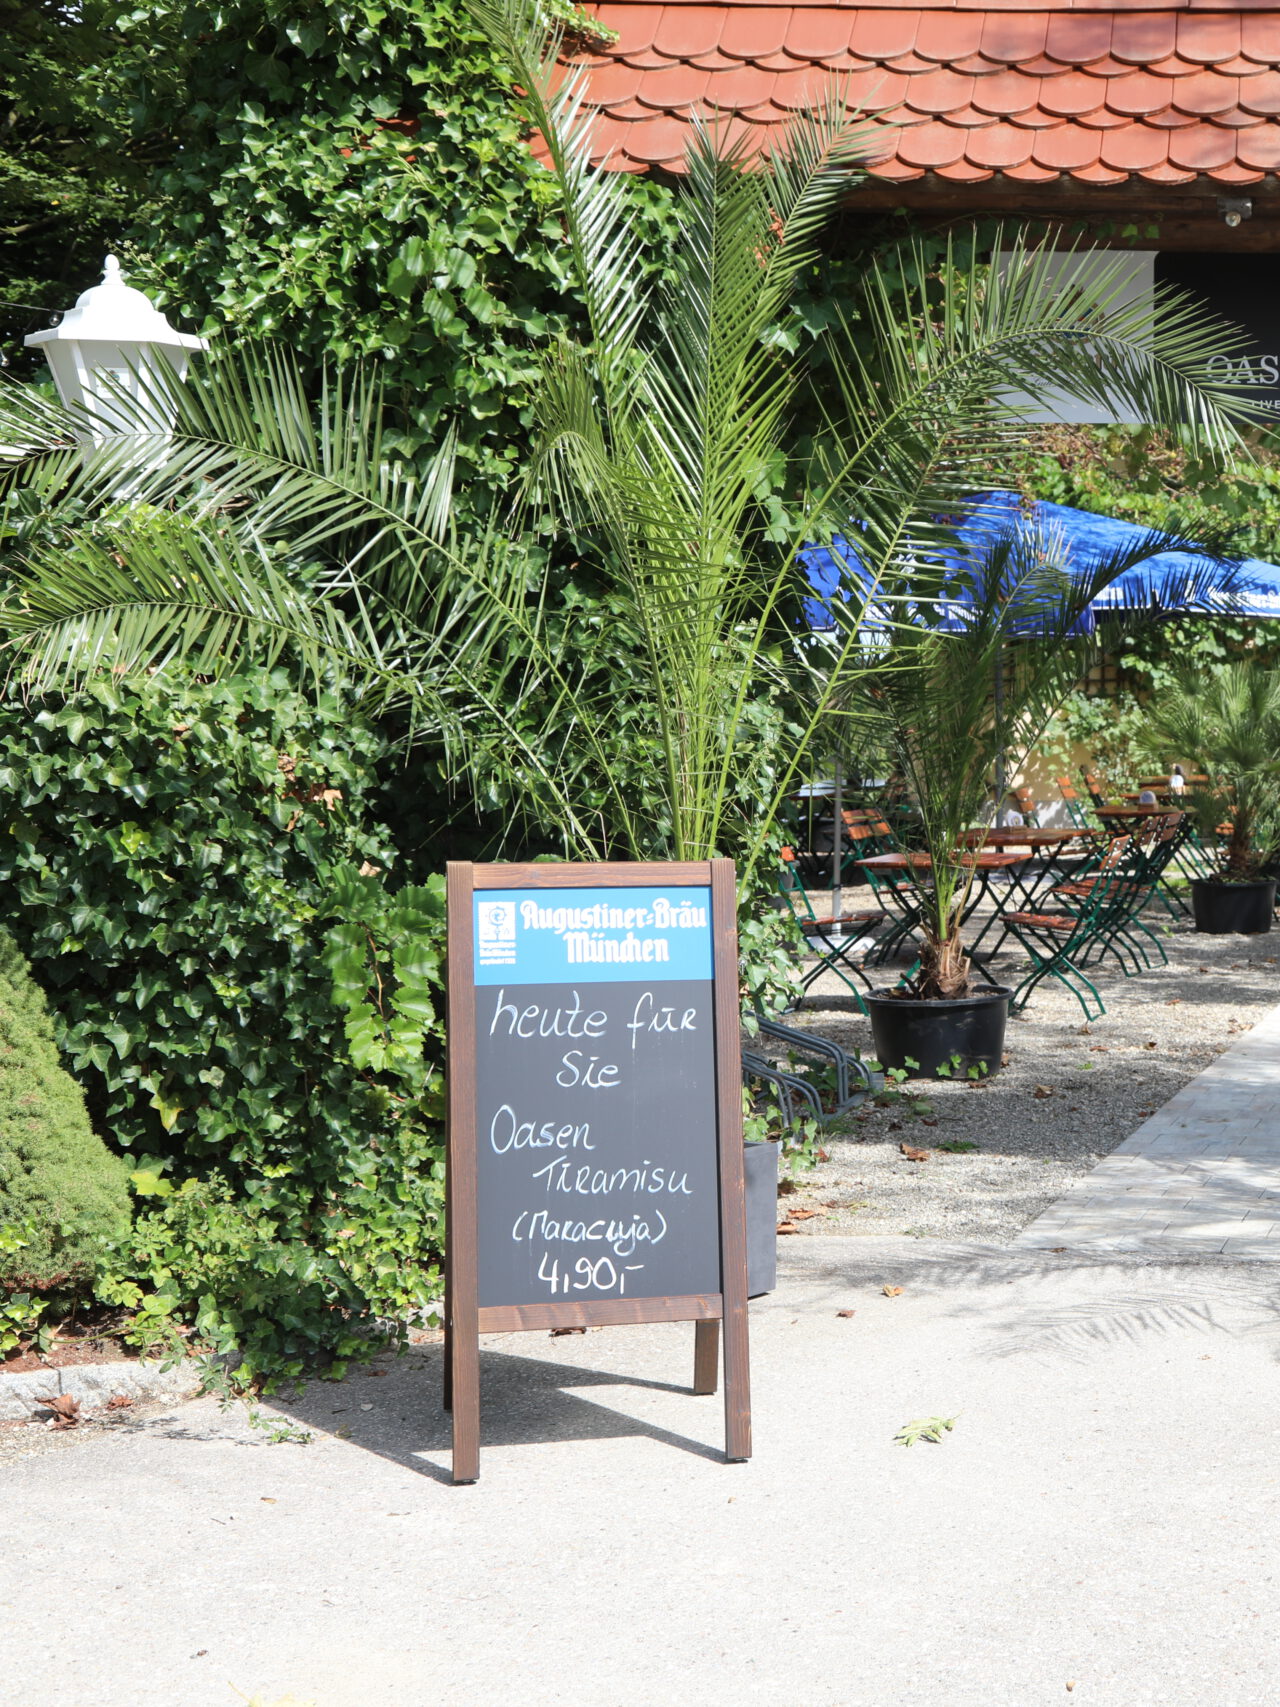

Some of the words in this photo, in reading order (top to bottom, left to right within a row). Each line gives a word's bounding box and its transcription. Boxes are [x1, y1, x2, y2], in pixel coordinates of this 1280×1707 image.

[562, 932, 670, 964] München
[489, 988, 608, 1039] heute
[556, 1050, 622, 1089] Sie
[491, 1104, 596, 1155] Oasen
[532, 1155, 693, 1195] Tiramisu
